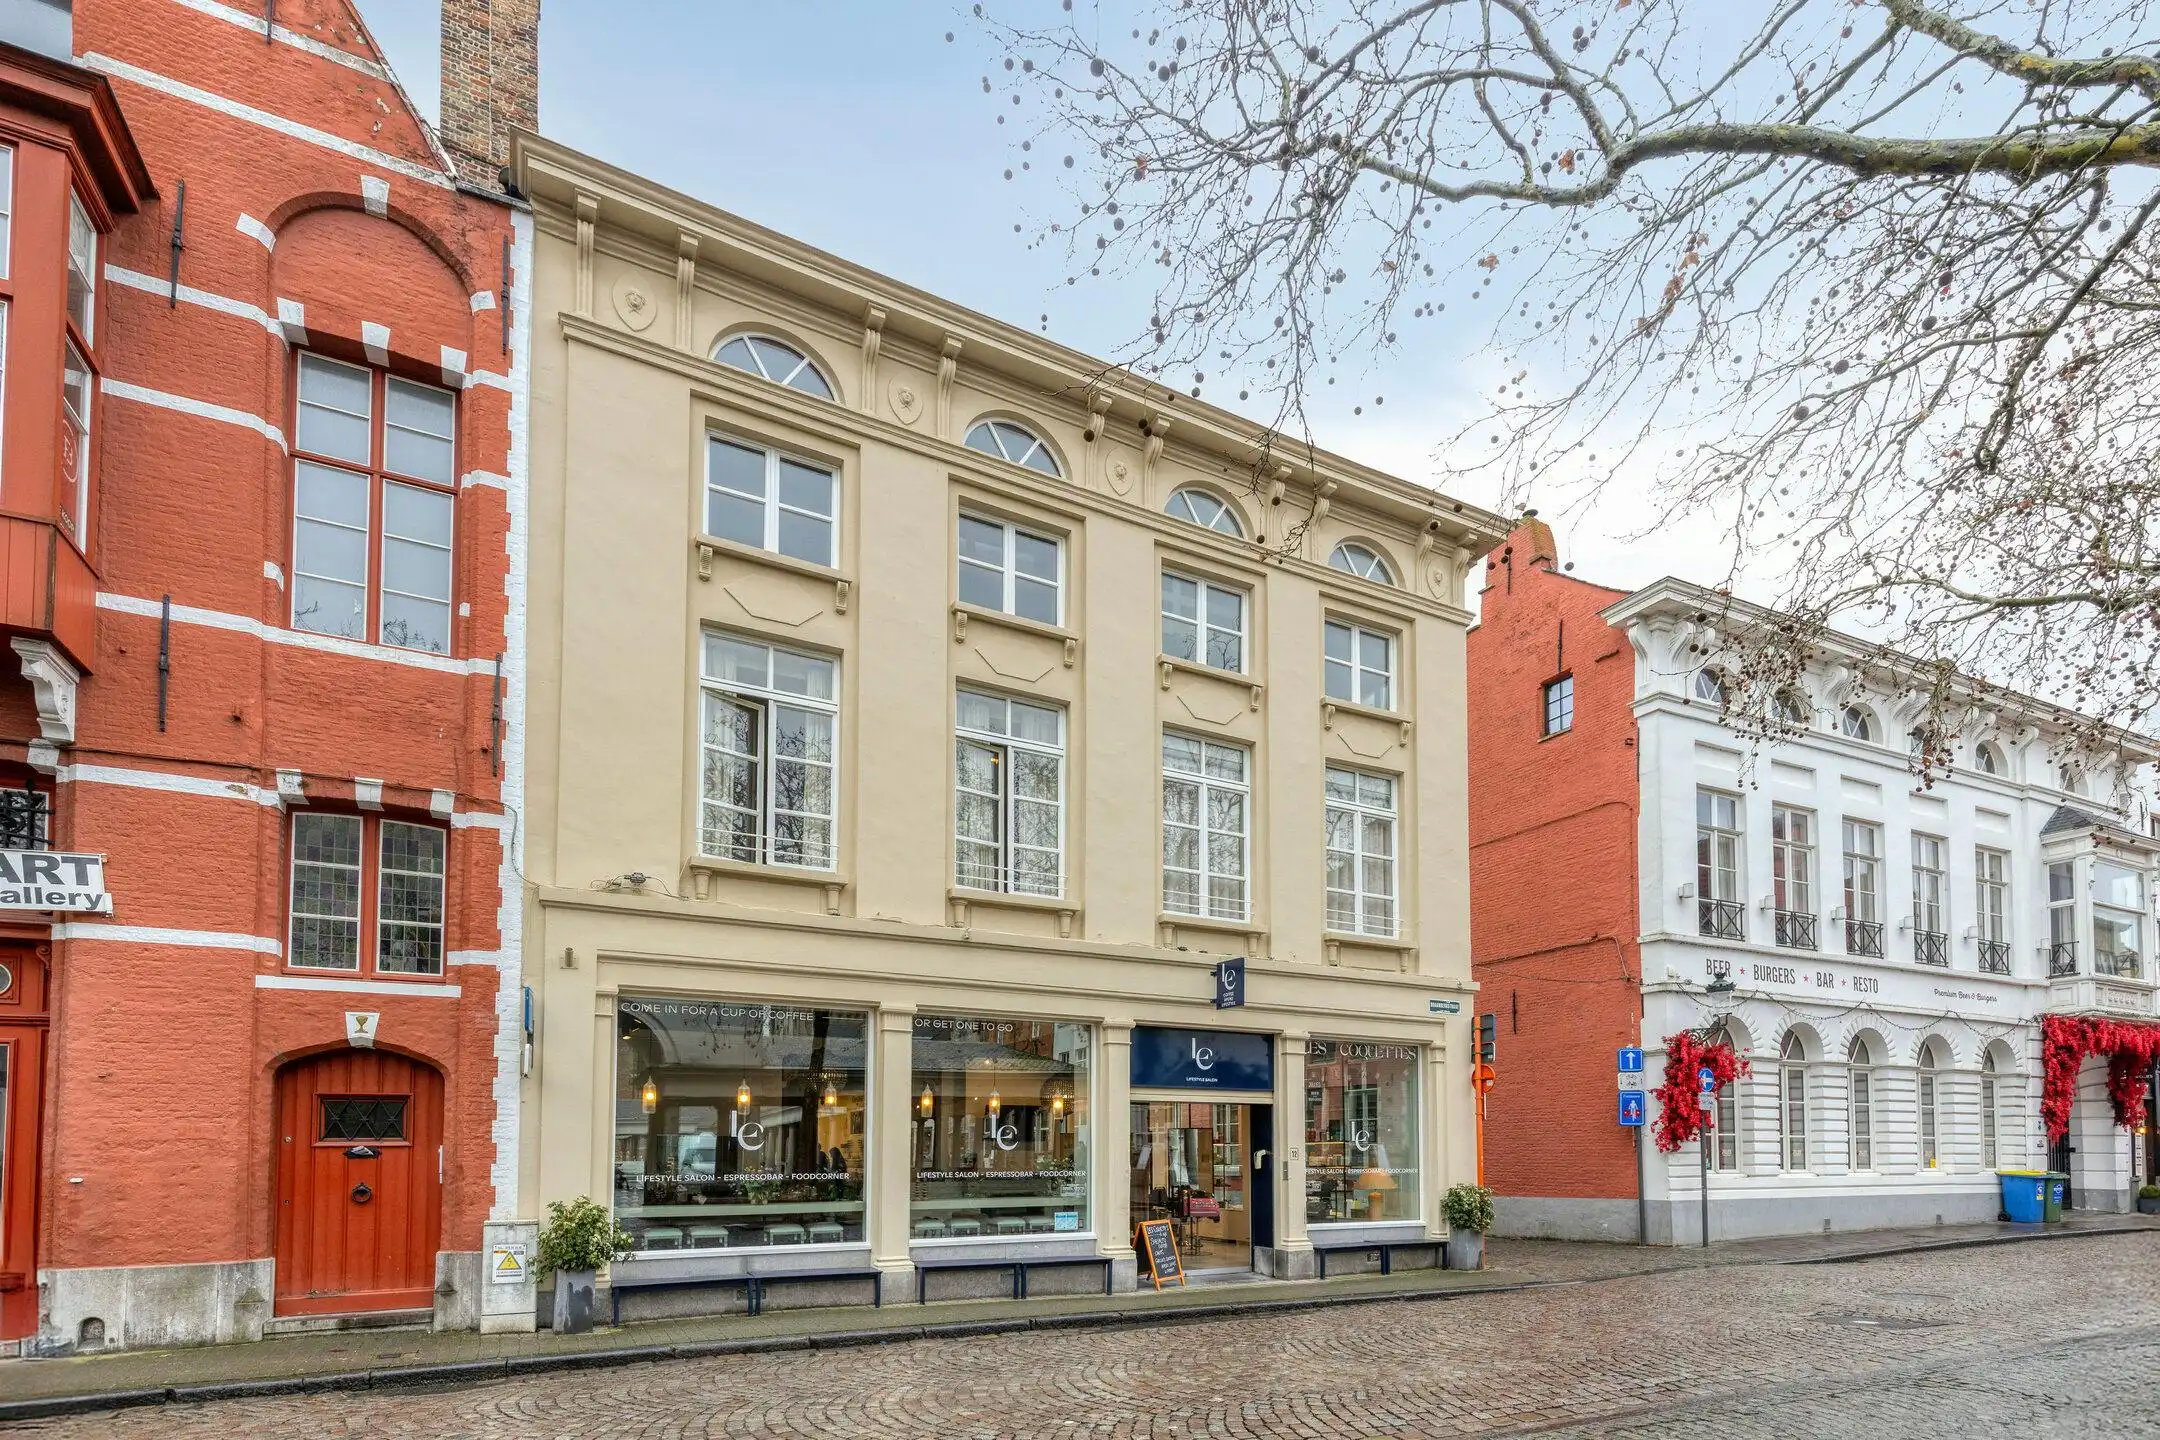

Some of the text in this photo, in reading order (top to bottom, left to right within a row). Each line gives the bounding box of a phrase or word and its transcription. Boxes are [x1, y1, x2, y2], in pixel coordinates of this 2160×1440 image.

[0, 886, 103, 910] allery
[1706, 958, 1879, 994] BEER BURGERS BAR RESTO
[1934, 988, 1958, 998] Premium
[1976, 993, 1998, 1004] Burgers
[620, 1003, 814, 1021] COME IN FOR A CUP OF COFFEE
[914, 1018, 1013, 1032] OR GET ONE TO GO
[1340, 1043, 1417, 1061] COQUETTES
[636, 1174, 682, 1182] LIFESTYLE
[684, 1174, 715, 1182] SALON
[723, 1173, 784, 1182] ESPRESSOBAR
[791, 1172, 850, 1181] FOODCORNER
[917, 1171, 953, 1179] LIFESTYLE
[985, 1170, 1034, 1178] ESPRESSOBAR
[1039, 1169, 1087, 1177] FOODCORNER
